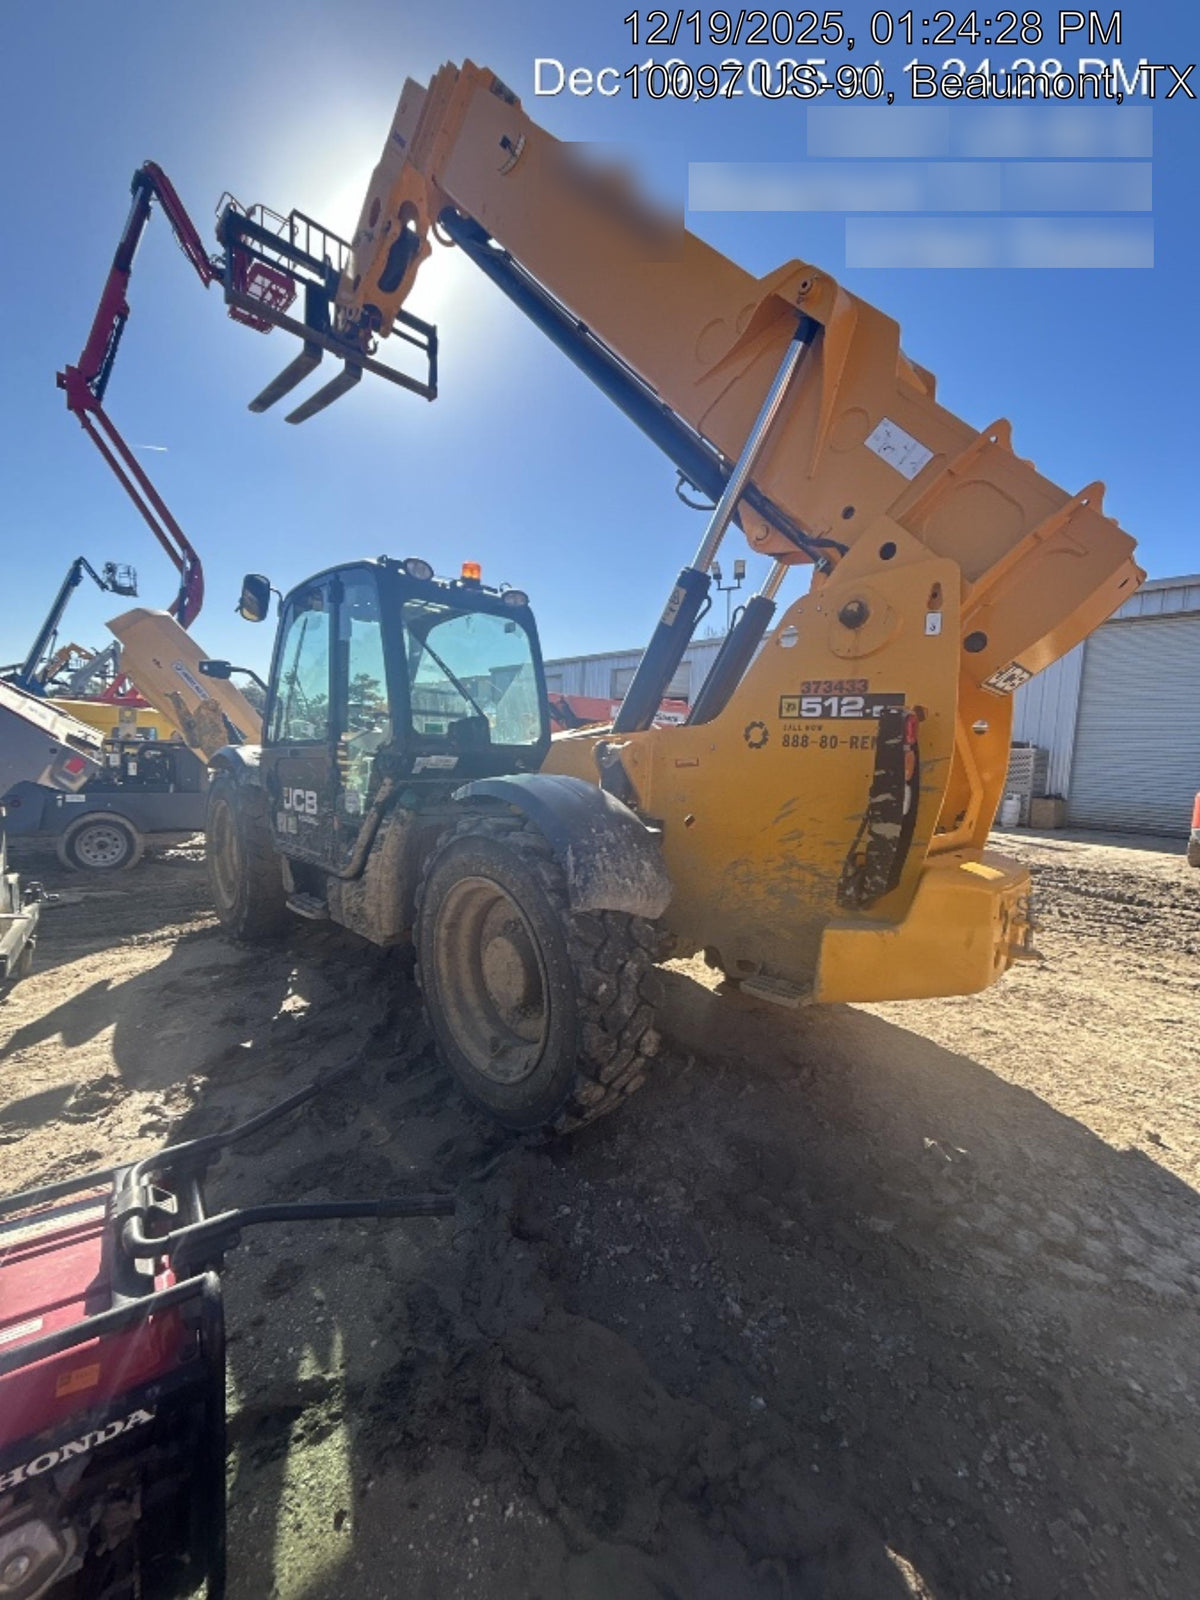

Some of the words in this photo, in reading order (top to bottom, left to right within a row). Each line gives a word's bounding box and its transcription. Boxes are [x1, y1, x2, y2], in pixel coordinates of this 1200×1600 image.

[801, 679, 868, 694] 373433
[283, 787, 317, 815] JCB
[0, 1409, 155, 1492] HONDA
